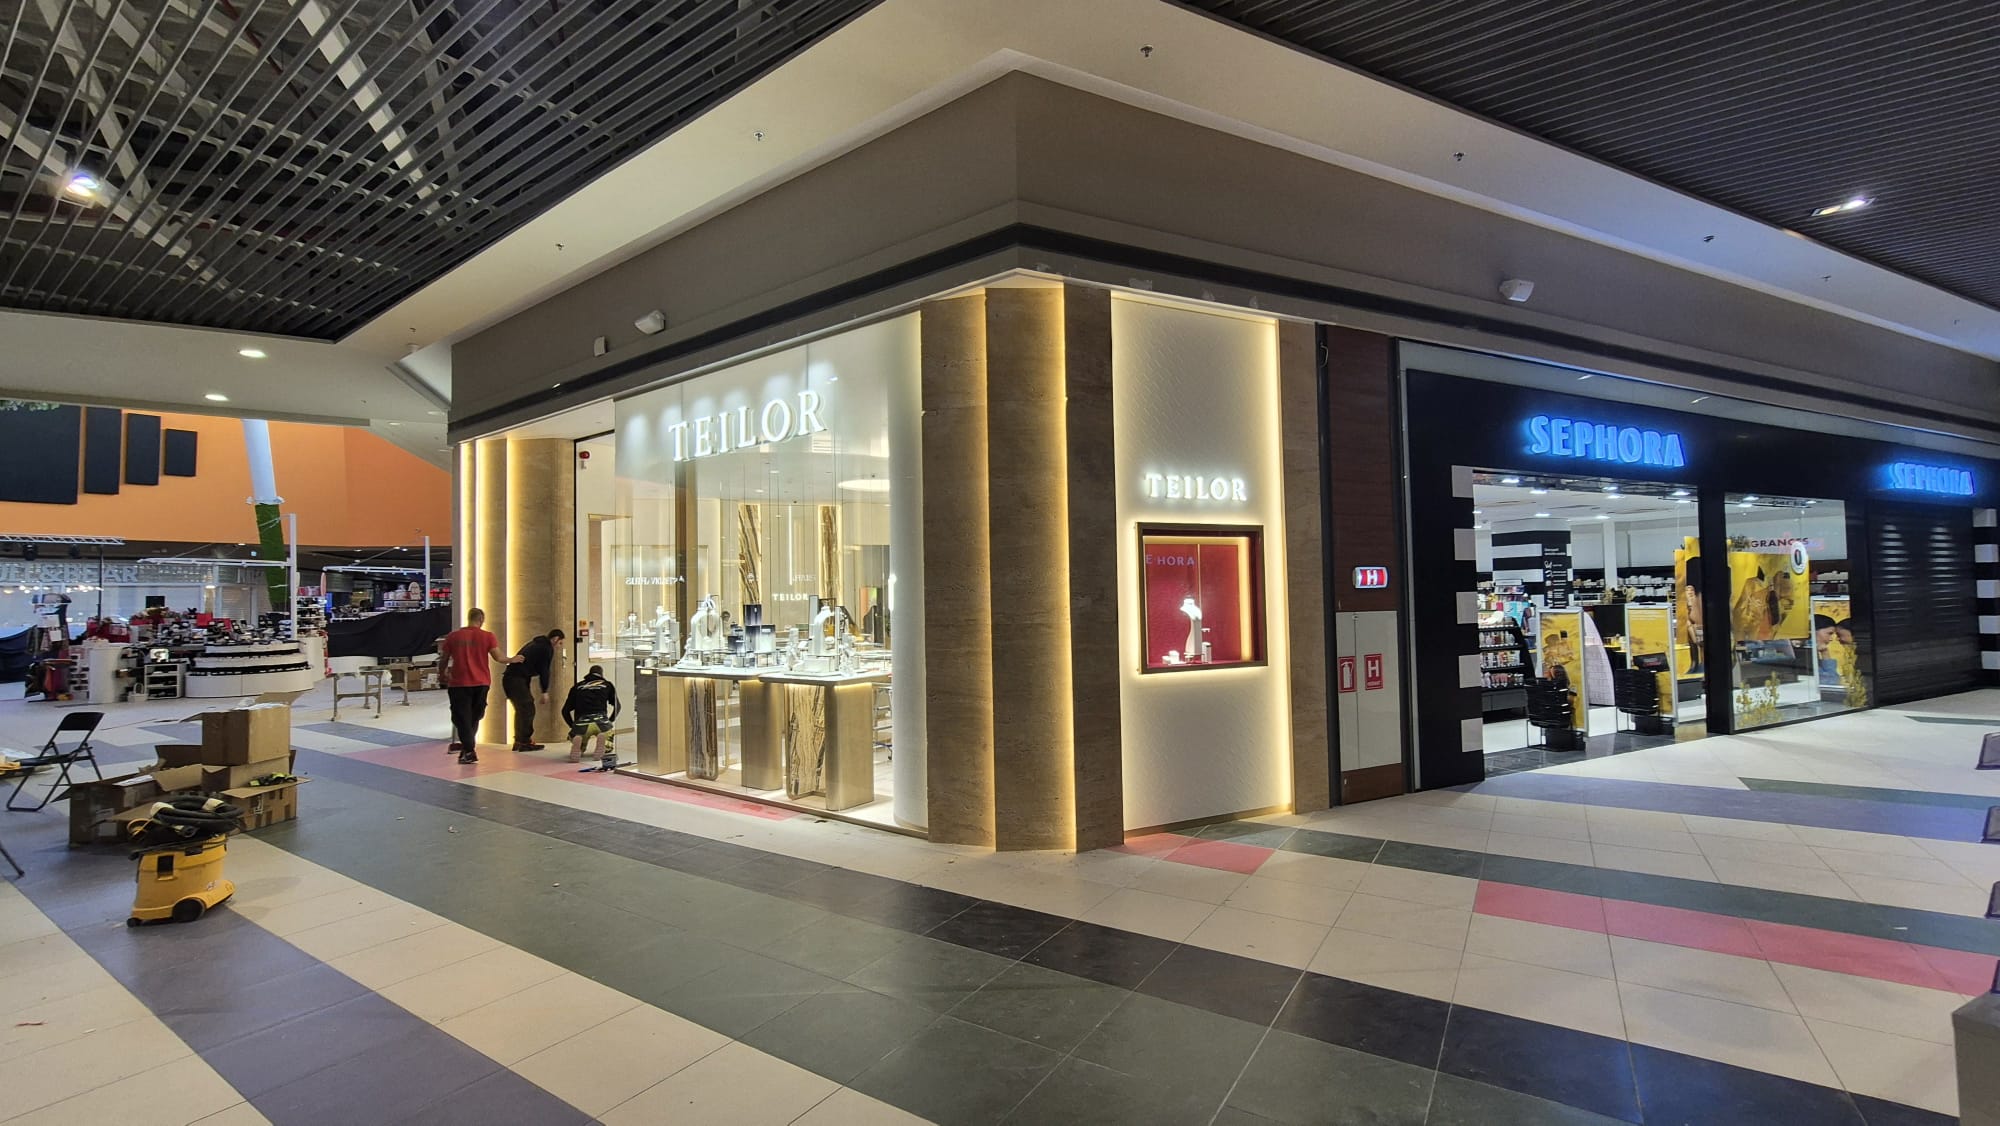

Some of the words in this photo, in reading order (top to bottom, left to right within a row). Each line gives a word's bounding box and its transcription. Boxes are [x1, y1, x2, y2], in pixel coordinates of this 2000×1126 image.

[668, 390, 826, 462] TEILOR
[1530, 415, 1685, 467] SEPHORA
[1144, 473, 1247, 501] TEILOR
[1889, 462, 1974, 495] SEPHORA
[1366, 569, 1378, 586] H
[772, 593, 809, 601] TEILOR
[1367, 660, 1380, 678] H
